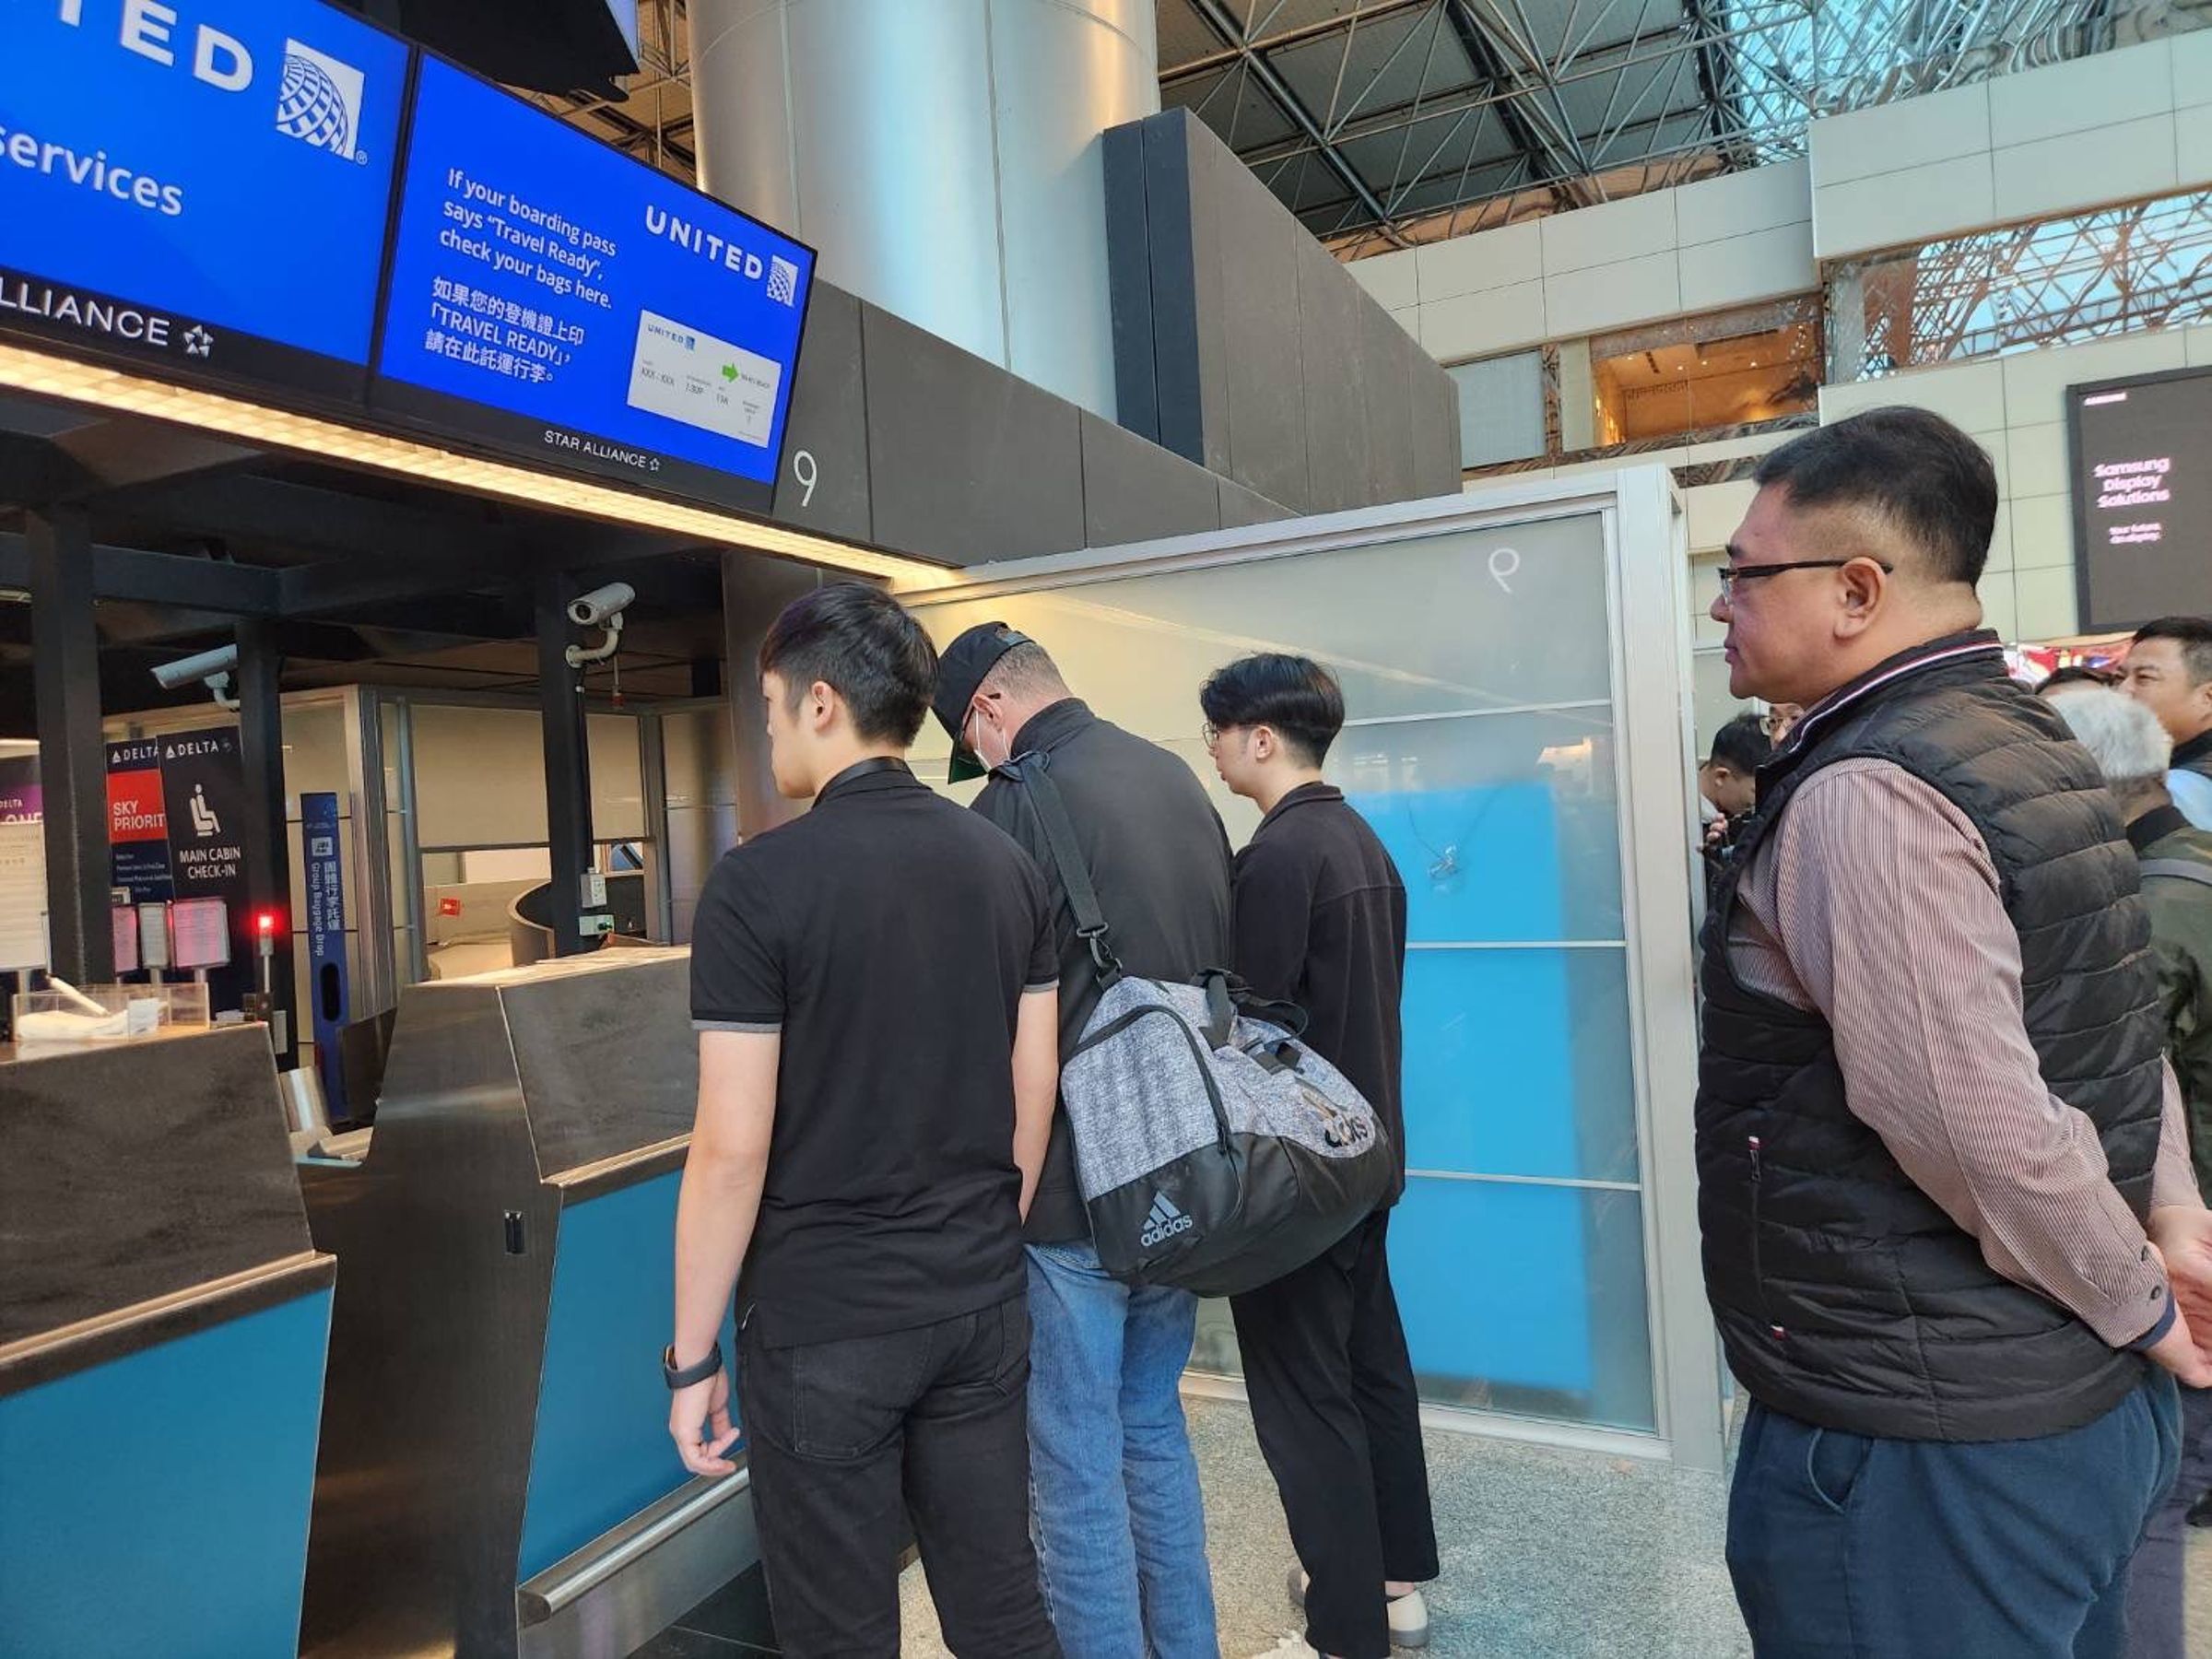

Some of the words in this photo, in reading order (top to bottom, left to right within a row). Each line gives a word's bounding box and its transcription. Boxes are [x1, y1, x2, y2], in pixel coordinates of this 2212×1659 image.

[0, 124, 183, 217] ervices
[443, 200, 484, 229] says
[488, 215, 545, 254] “Travel
[448, 168, 464, 190] If
[463, 179, 506, 208] your
[509, 194, 581, 245] boarding
[582, 230, 617, 257] pass
[646, 205, 763, 279] UNITED
[440, 229, 491, 263] check
[493, 251, 534, 277] your
[536, 264, 572, 295] bags
[575, 279, 613, 310] here.
[432, 276, 585, 347] 如果您的登機證上印
[648, 324, 685, 345] UNITED
[425, 328, 554, 384] 請在此託運行李。
[544, 430, 580, 451] STAR
[582, 441, 647, 469] ALLIANCE
[793, 450, 818, 507] 9
[2093, 457, 2171, 477] Samsung
[2102, 475, 2162, 492] Display
[2097, 488, 2171, 508] Solutions
[179, 740, 219, 757] DELTA
[113, 800, 138, 817] SKY
[180, 849, 208, 864] MAIN
[209, 846, 241, 862] CABIN
[188, 865, 236, 880] CHECK-IN
[312, 863, 322, 890] Group
[313, 891, 324, 933] Baggage
[316, 934, 324, 957] Drop
[1140, 1213, 1193, 1247] adidas
